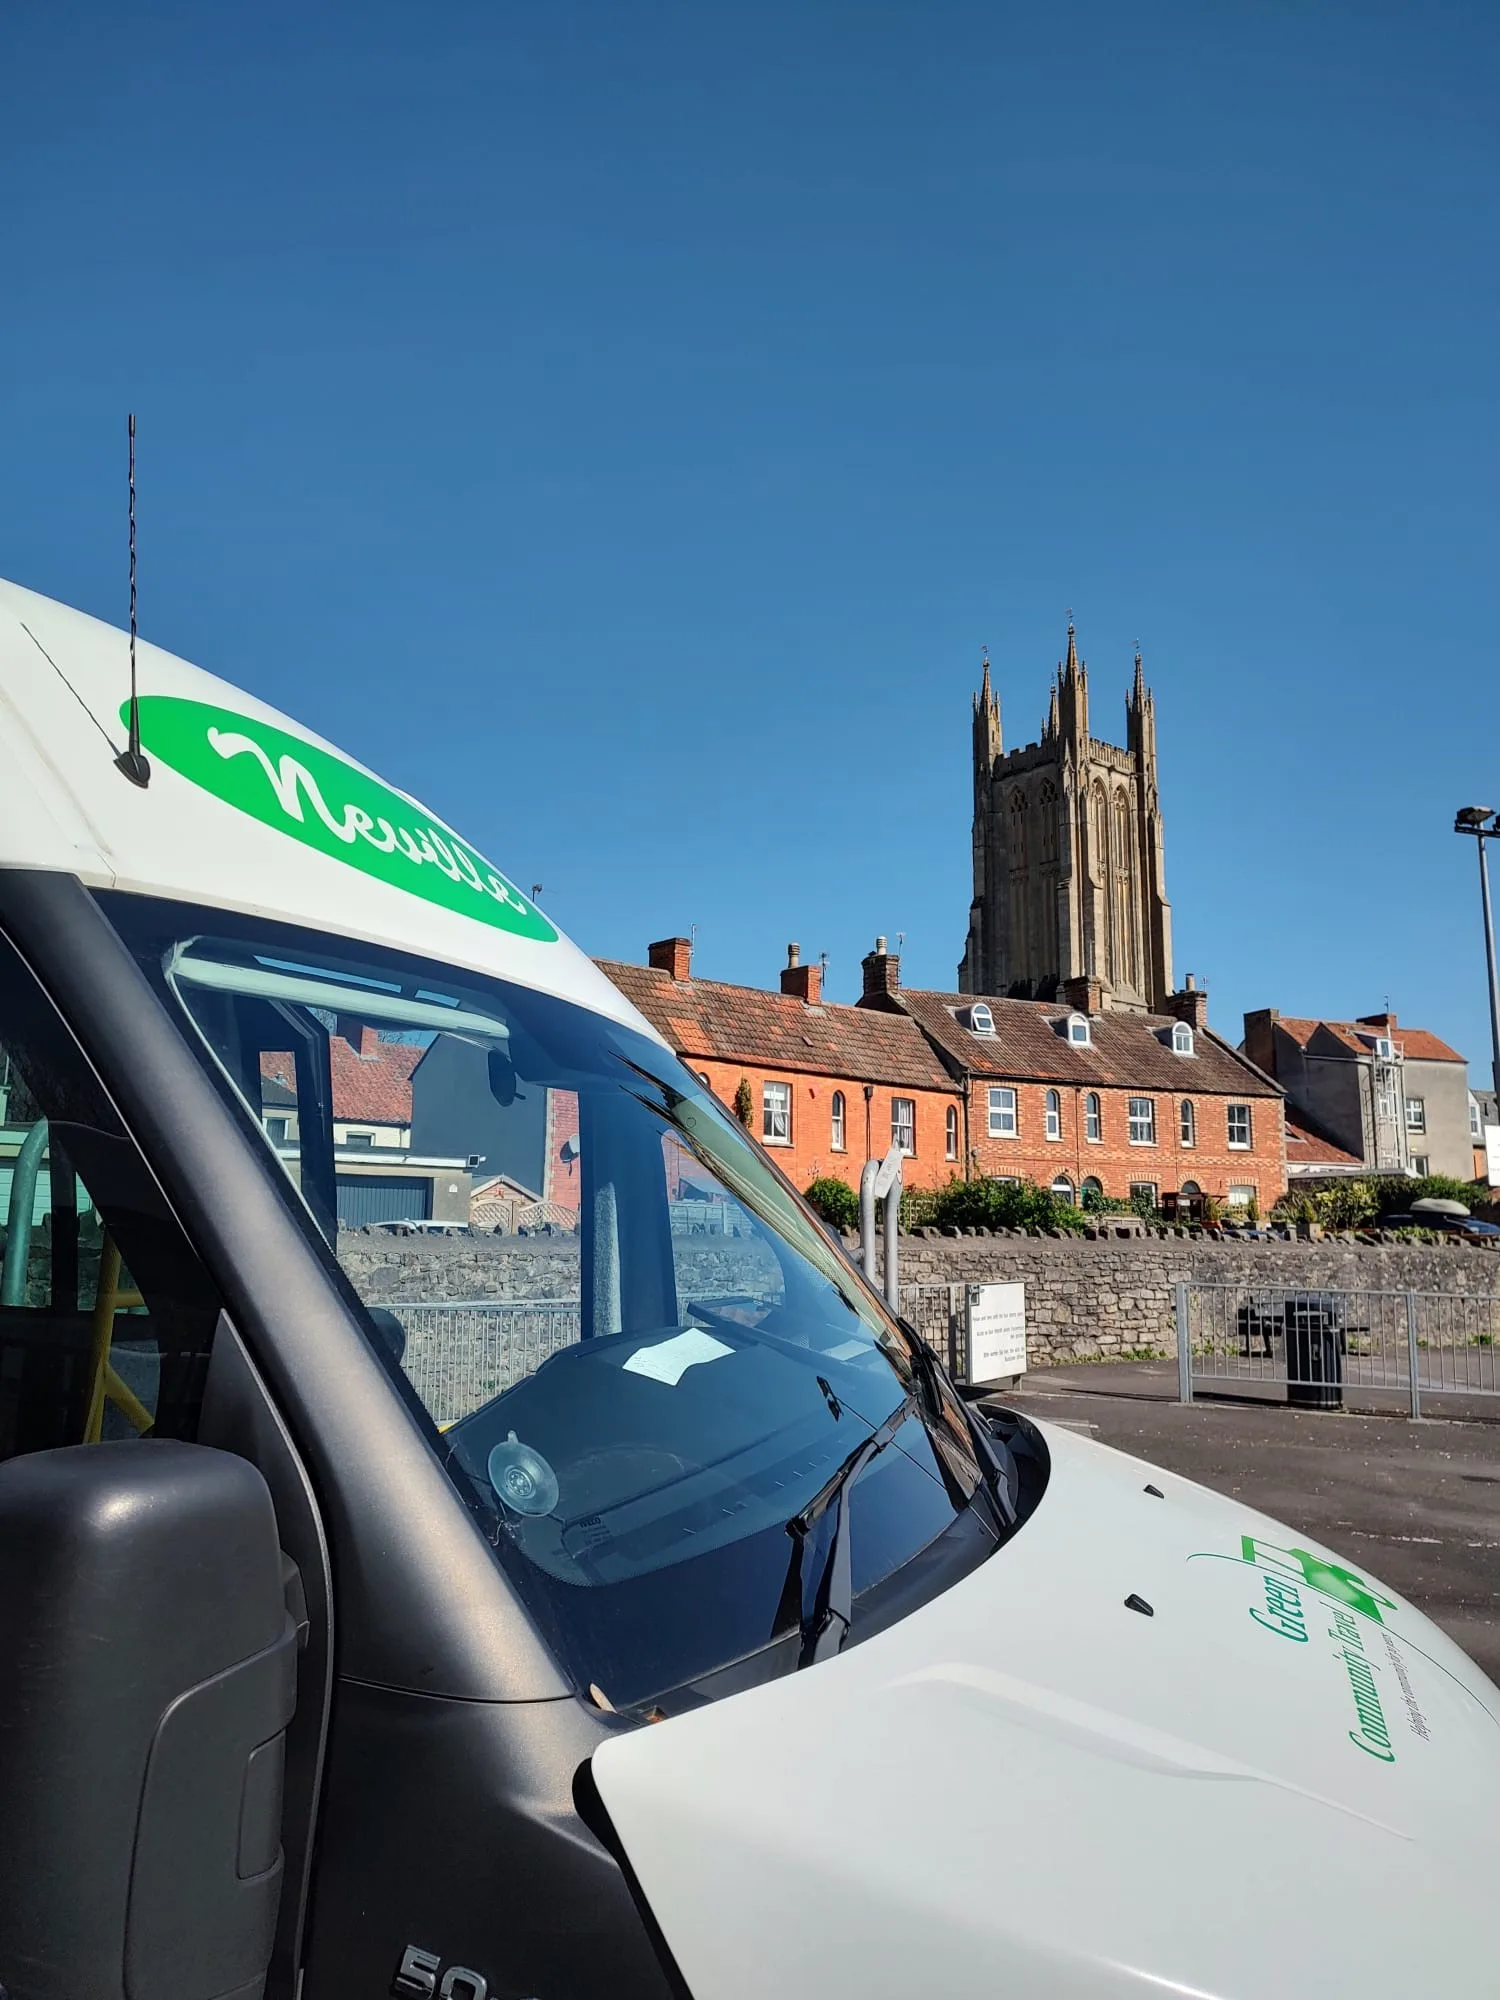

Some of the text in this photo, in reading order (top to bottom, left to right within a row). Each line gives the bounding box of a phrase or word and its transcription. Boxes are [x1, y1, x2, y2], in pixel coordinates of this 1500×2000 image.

[207, 726, 528, 916] Neville
[1249, 1575, 1309, 1643] Green
[1319, 1600, 1395, 1763] Community Travel
